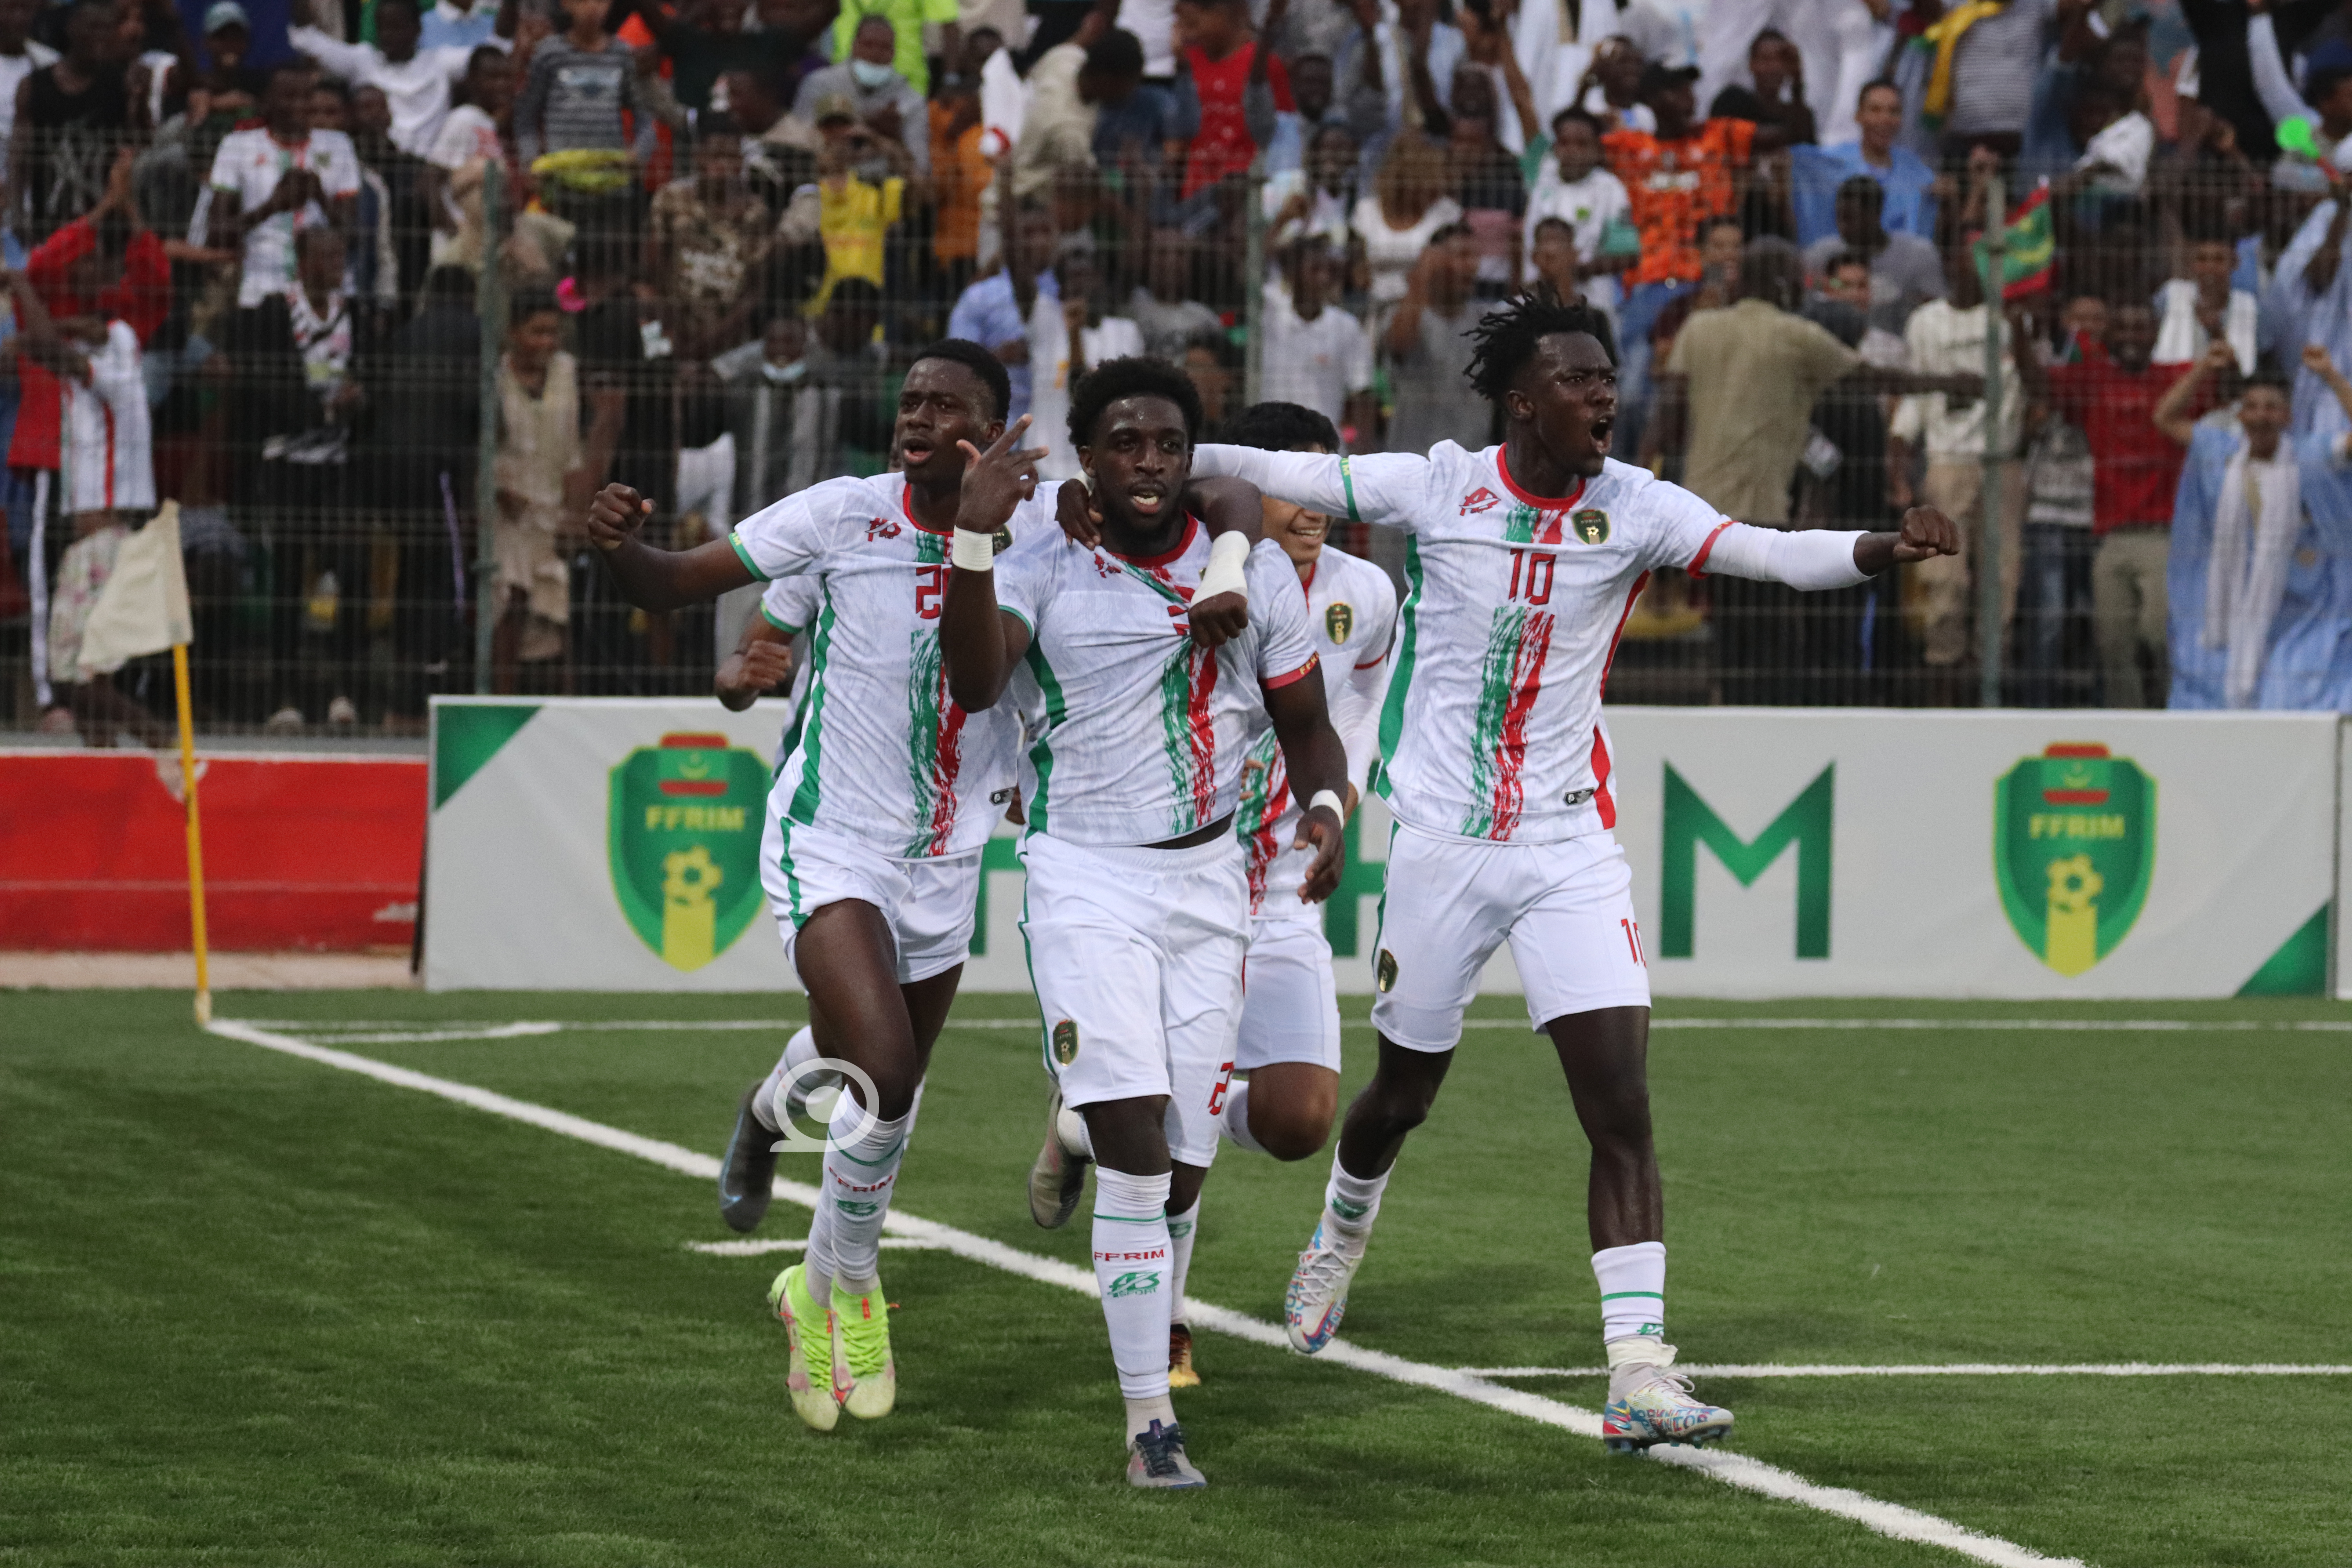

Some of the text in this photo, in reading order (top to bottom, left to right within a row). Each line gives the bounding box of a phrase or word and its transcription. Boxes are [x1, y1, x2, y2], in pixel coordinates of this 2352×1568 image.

[1508, 548, 1557, 605] 10
[645, 806, 745, 830] FFRIM
[2030, 814, 2125, 838] FFRIM
[1094, 1249, 1165, 1261] FFRIM
